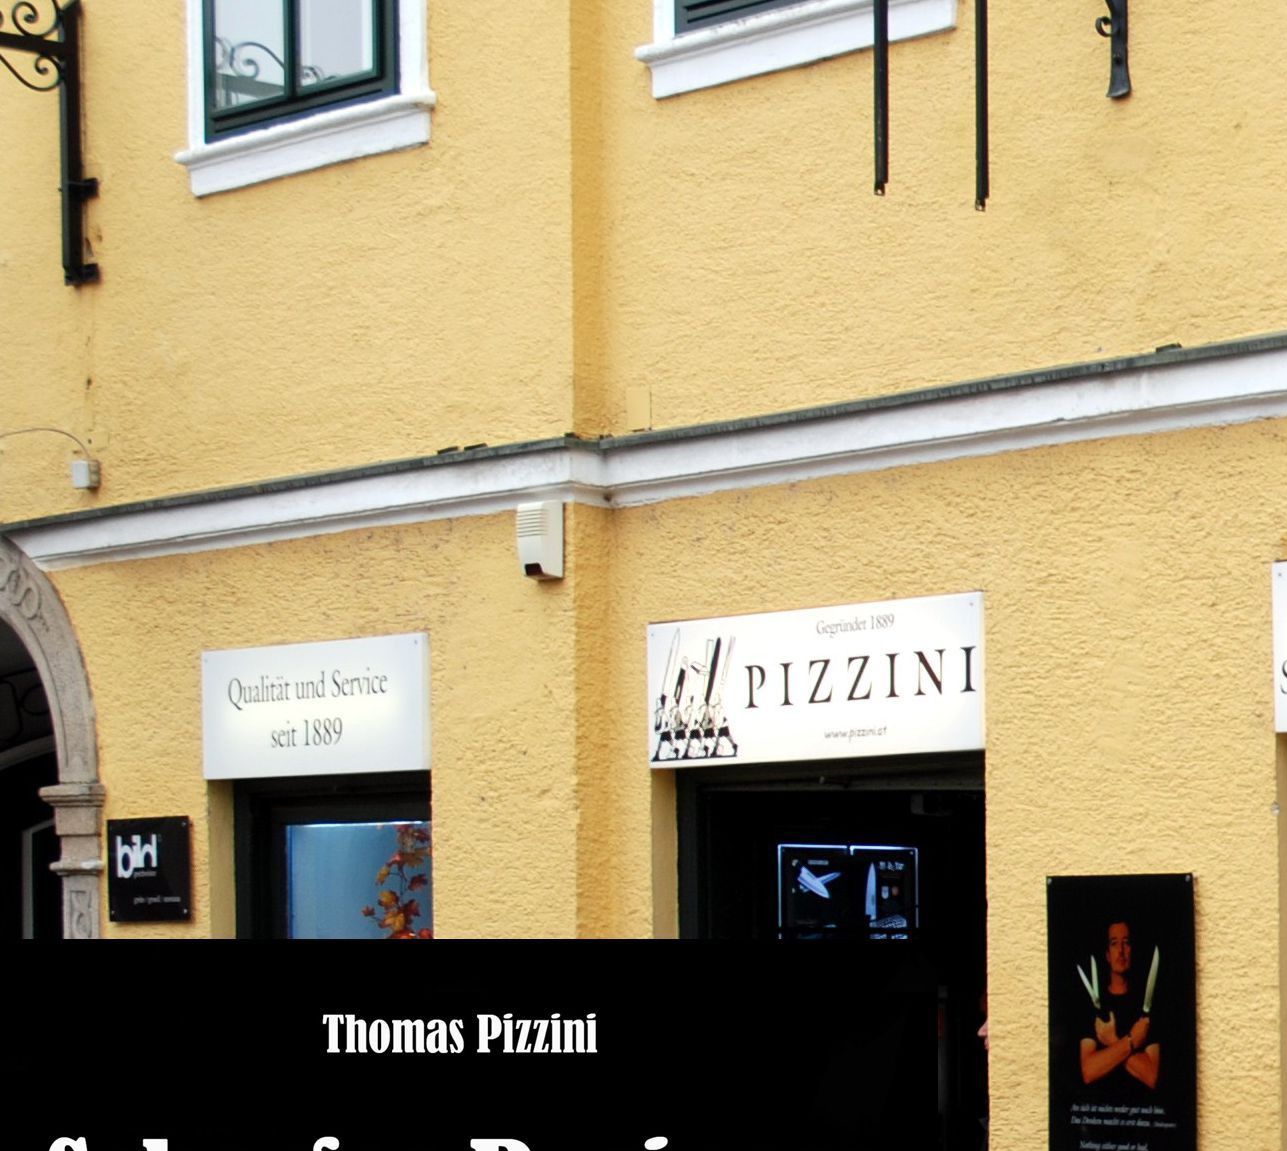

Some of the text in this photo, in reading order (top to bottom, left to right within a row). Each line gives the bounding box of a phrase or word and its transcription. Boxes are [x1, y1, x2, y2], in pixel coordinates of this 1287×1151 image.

[816, 614, 894, 638] Gegründet 1889
[228, 668, 387, 711] Qualität und Service
[745, 646, 975, 708] PIZZINI
[270, 717, 343, 748] seit 1889
